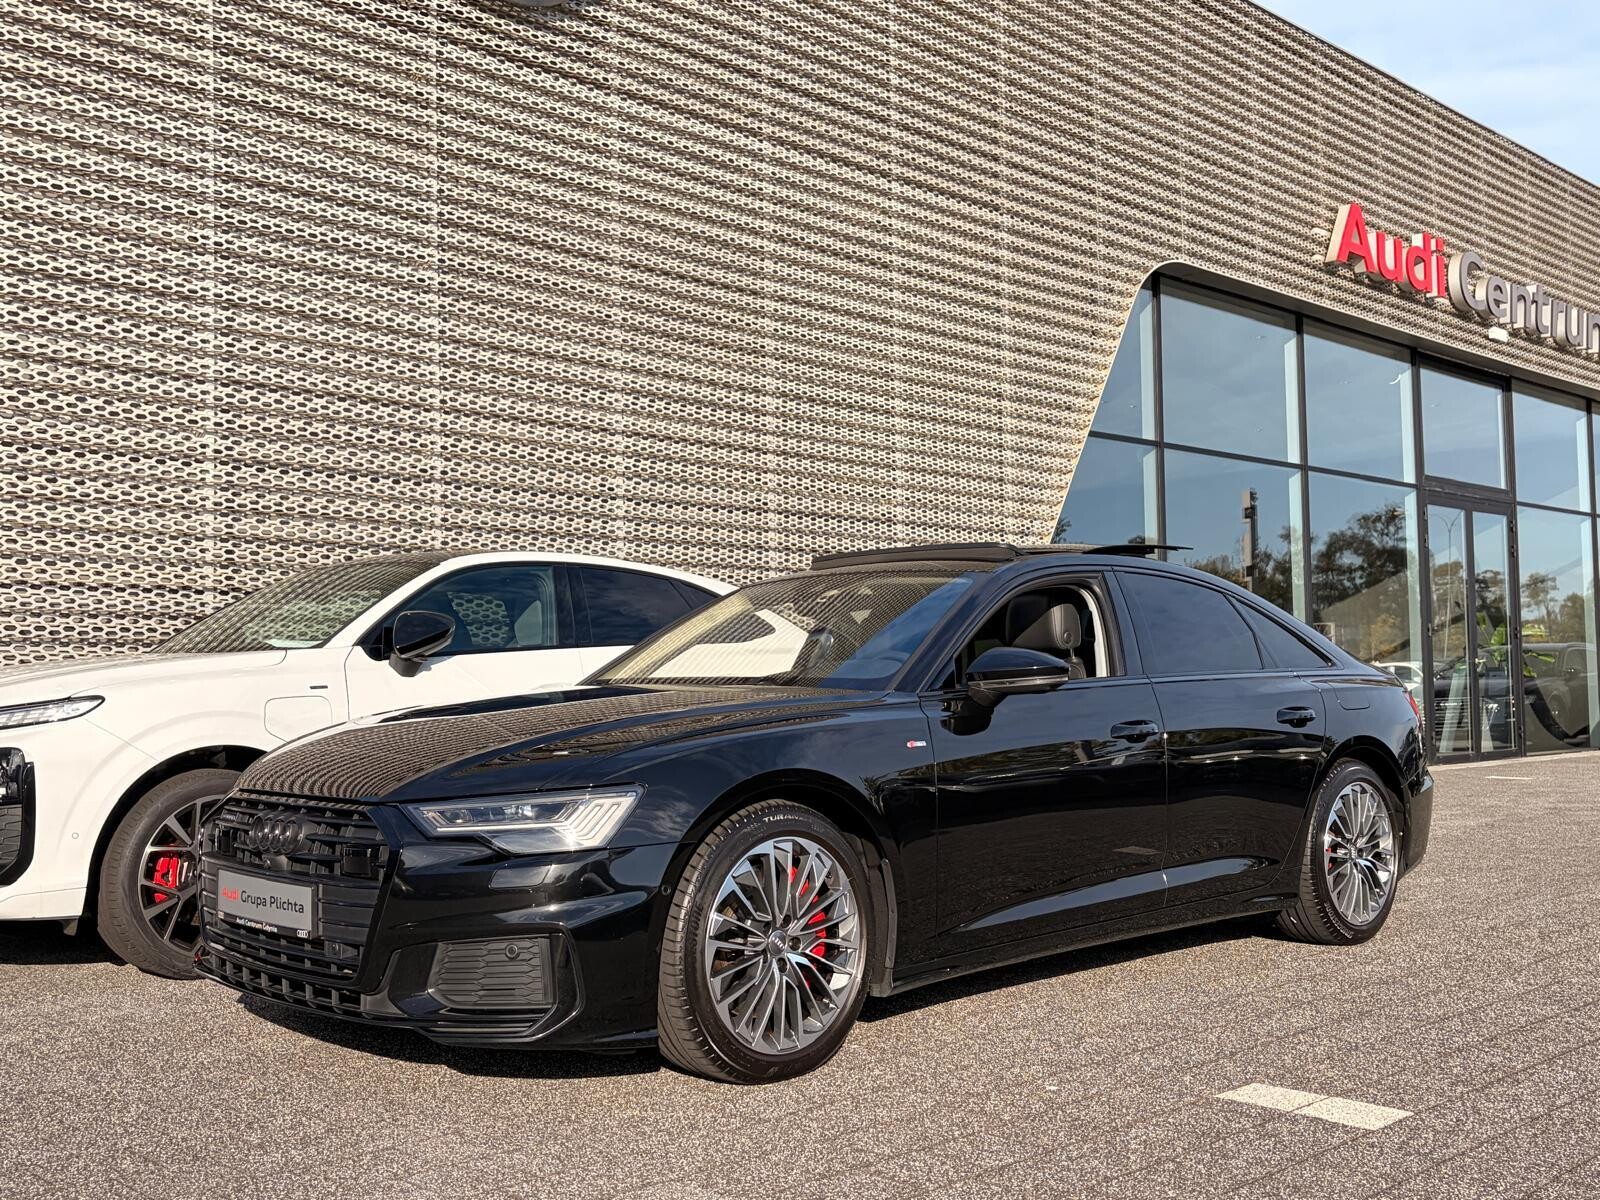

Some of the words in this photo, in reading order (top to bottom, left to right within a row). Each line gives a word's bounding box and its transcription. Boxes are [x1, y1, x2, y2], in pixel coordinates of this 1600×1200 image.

[1328, 202, 1447, 298] Audi
[221, 886, 239, 901] Audi
[241, 890, 267, 909] Grupa
[269, 895, 305, 914] Plichta
